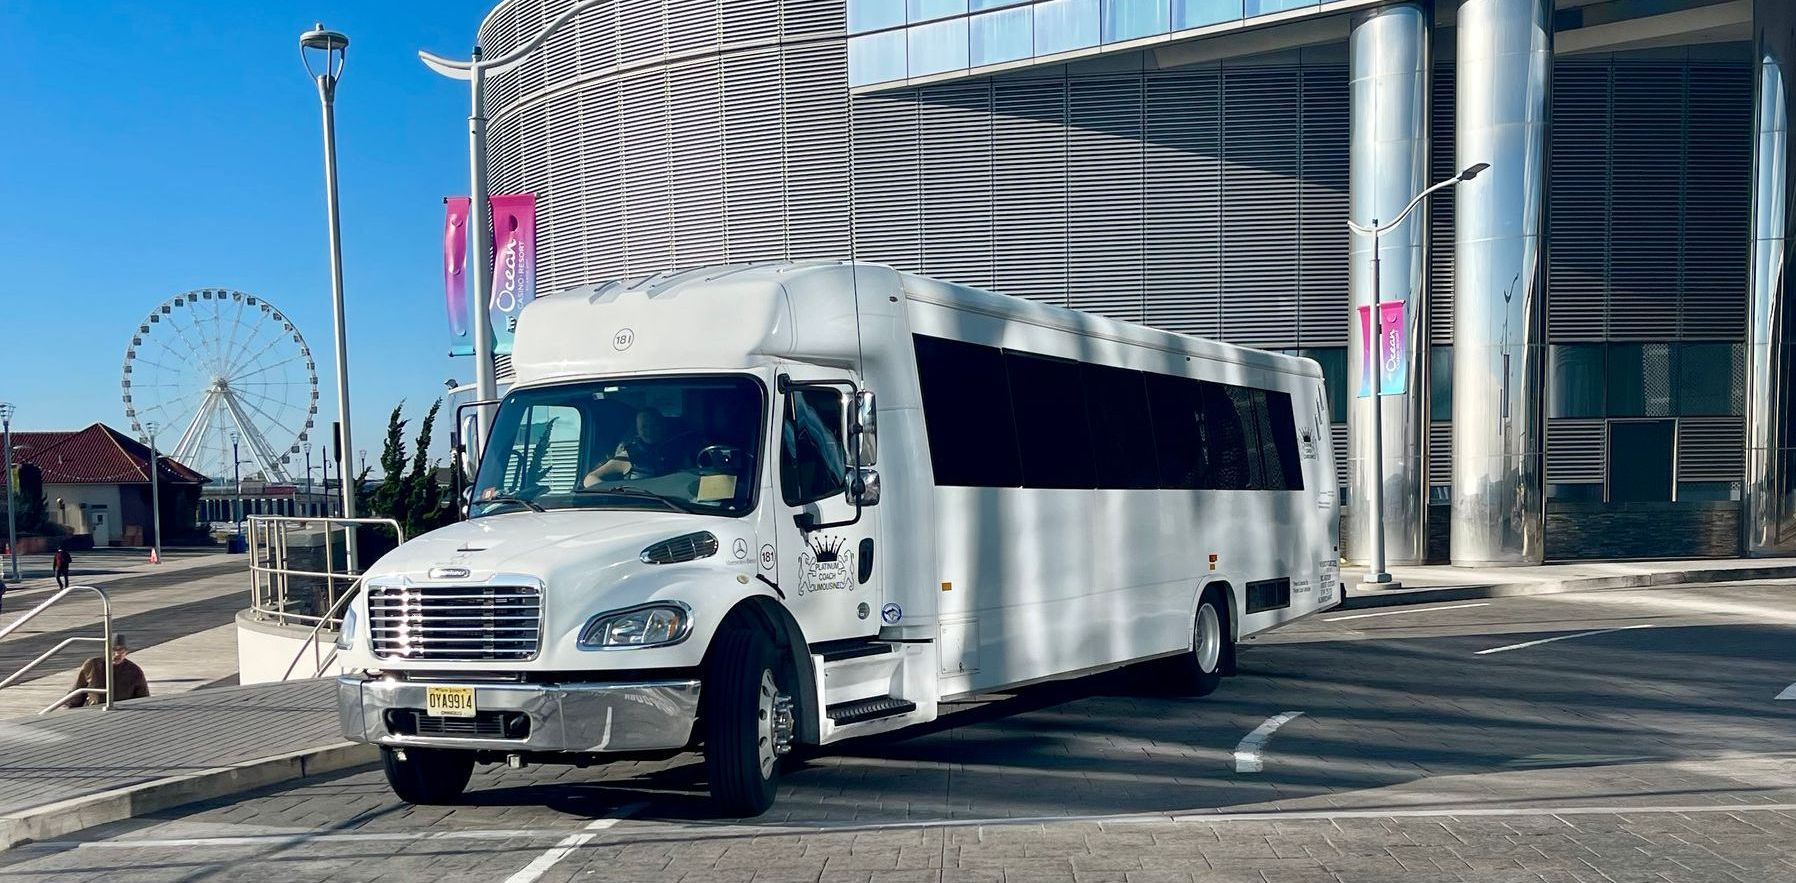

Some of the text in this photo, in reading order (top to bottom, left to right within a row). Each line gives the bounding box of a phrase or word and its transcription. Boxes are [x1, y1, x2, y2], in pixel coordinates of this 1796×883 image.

[496, 238, 517, 313] Ocean
[517, 277, 525, 310] CASINO
[616, 334, 632, 345] 181
[1385, 328, 1396, 372] Ocean
[761, 551, 775, 563] 181
[814, 561, 840, 571] PLATINUM
[818, 572, 837, 581] COACH
